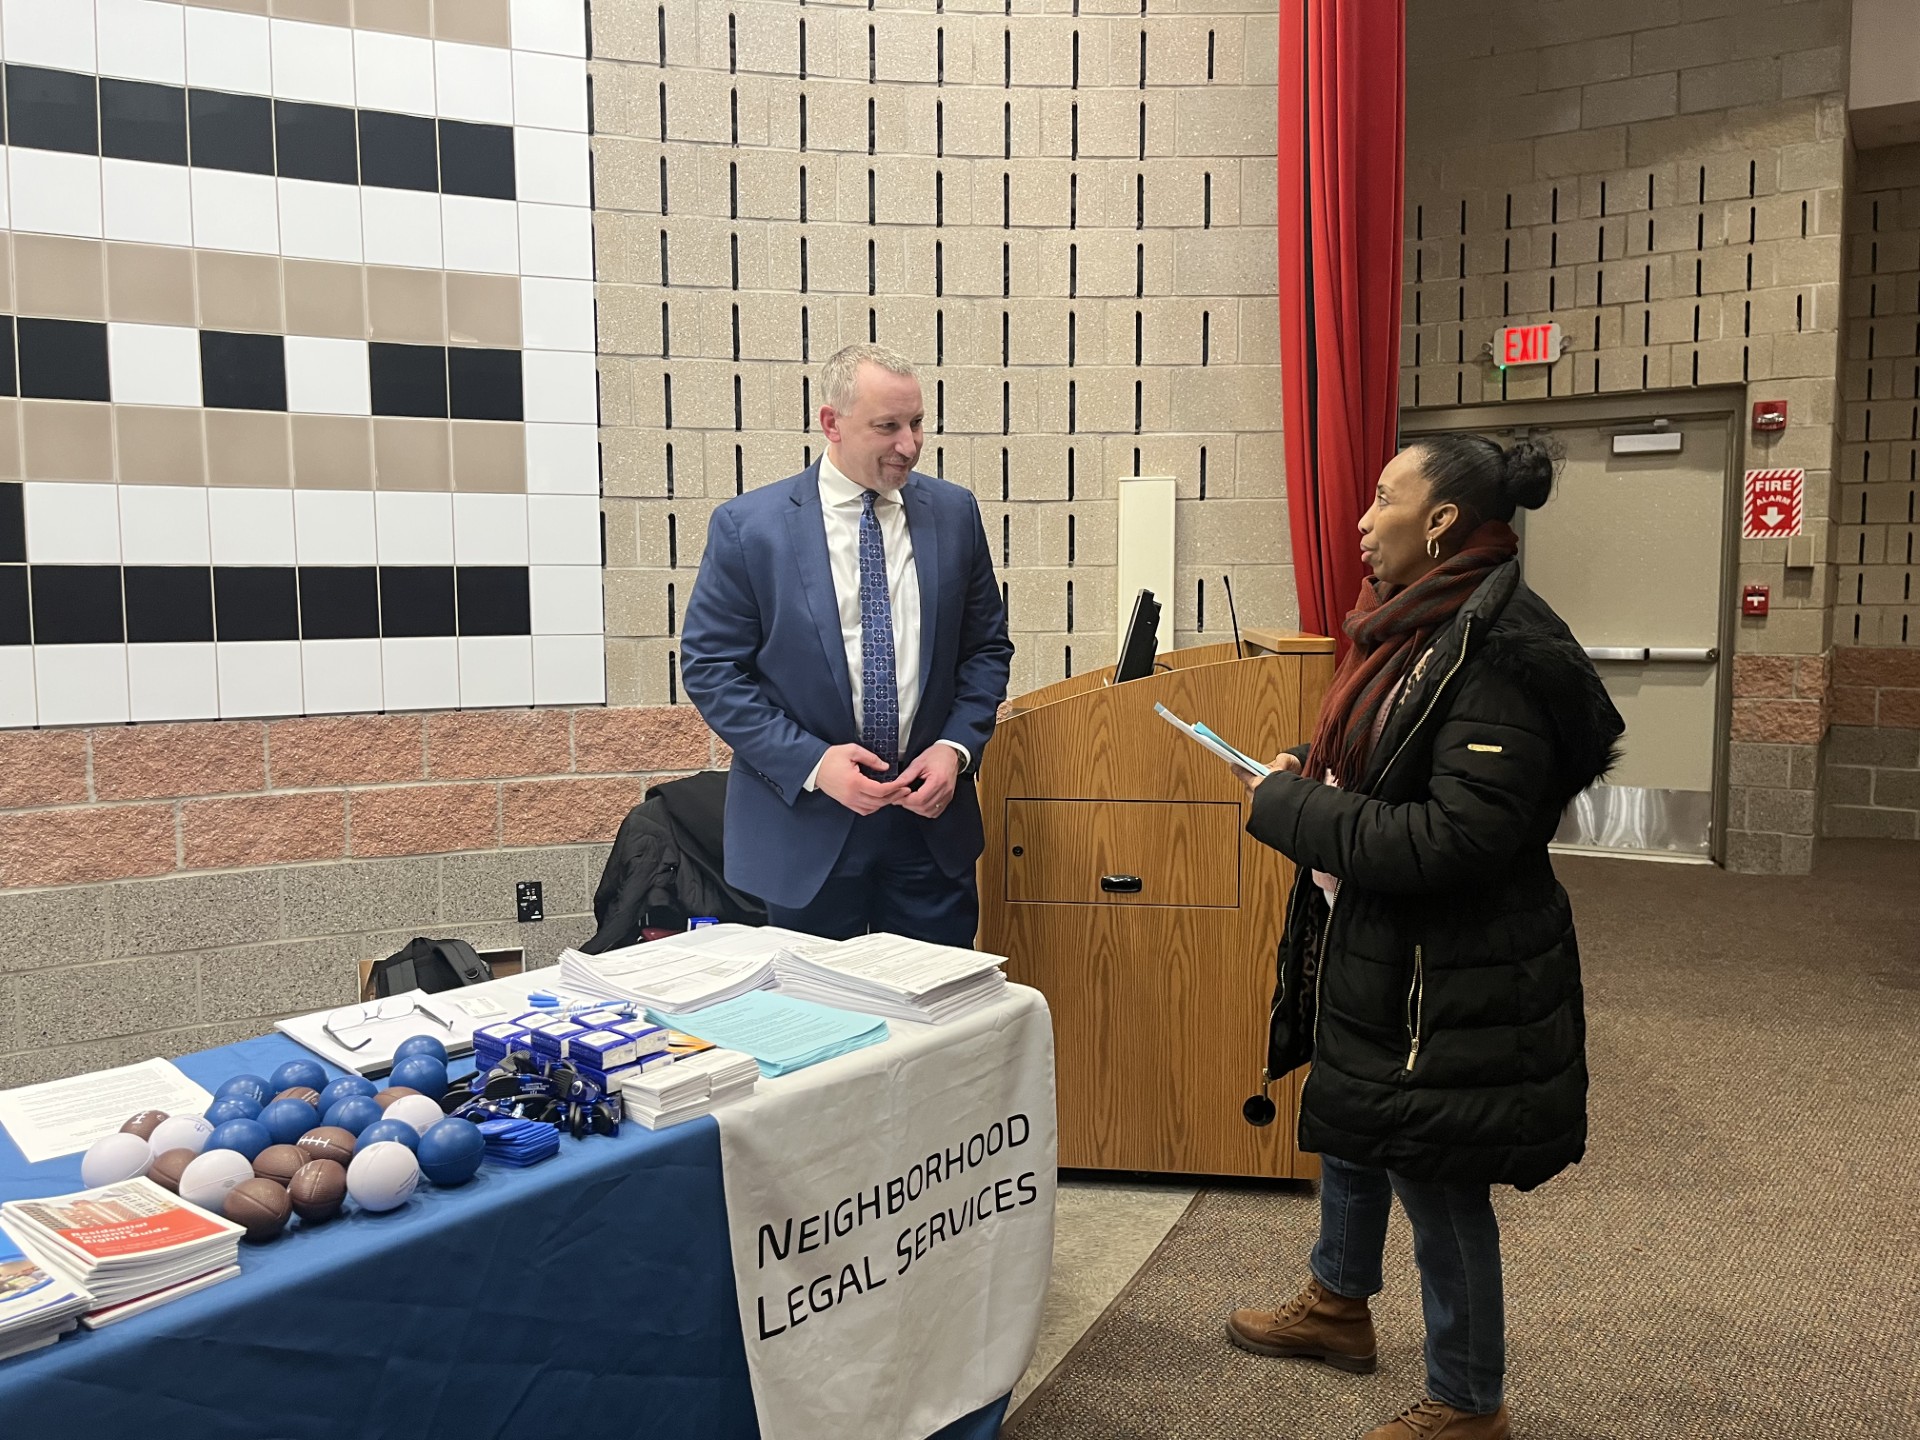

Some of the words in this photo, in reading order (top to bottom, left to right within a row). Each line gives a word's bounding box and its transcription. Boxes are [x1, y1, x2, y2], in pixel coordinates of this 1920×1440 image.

[1504, 324, 1552, 363] EXIT
[1755, 480, 1792, 492] FIRE
[1756, 495, 1792, 507] ALARM
[758, 1113, 1030, 1270] NEIGHBORHOOD
[71, 1221, 148, 1237] Residential
[82, 1234, 127, 1244] Rights
[129, 1226, 170, 1238] Guide
[757, 1256, 888, 1341] LEGAL
[896, 1171, 1037, 1276] SERVICES
